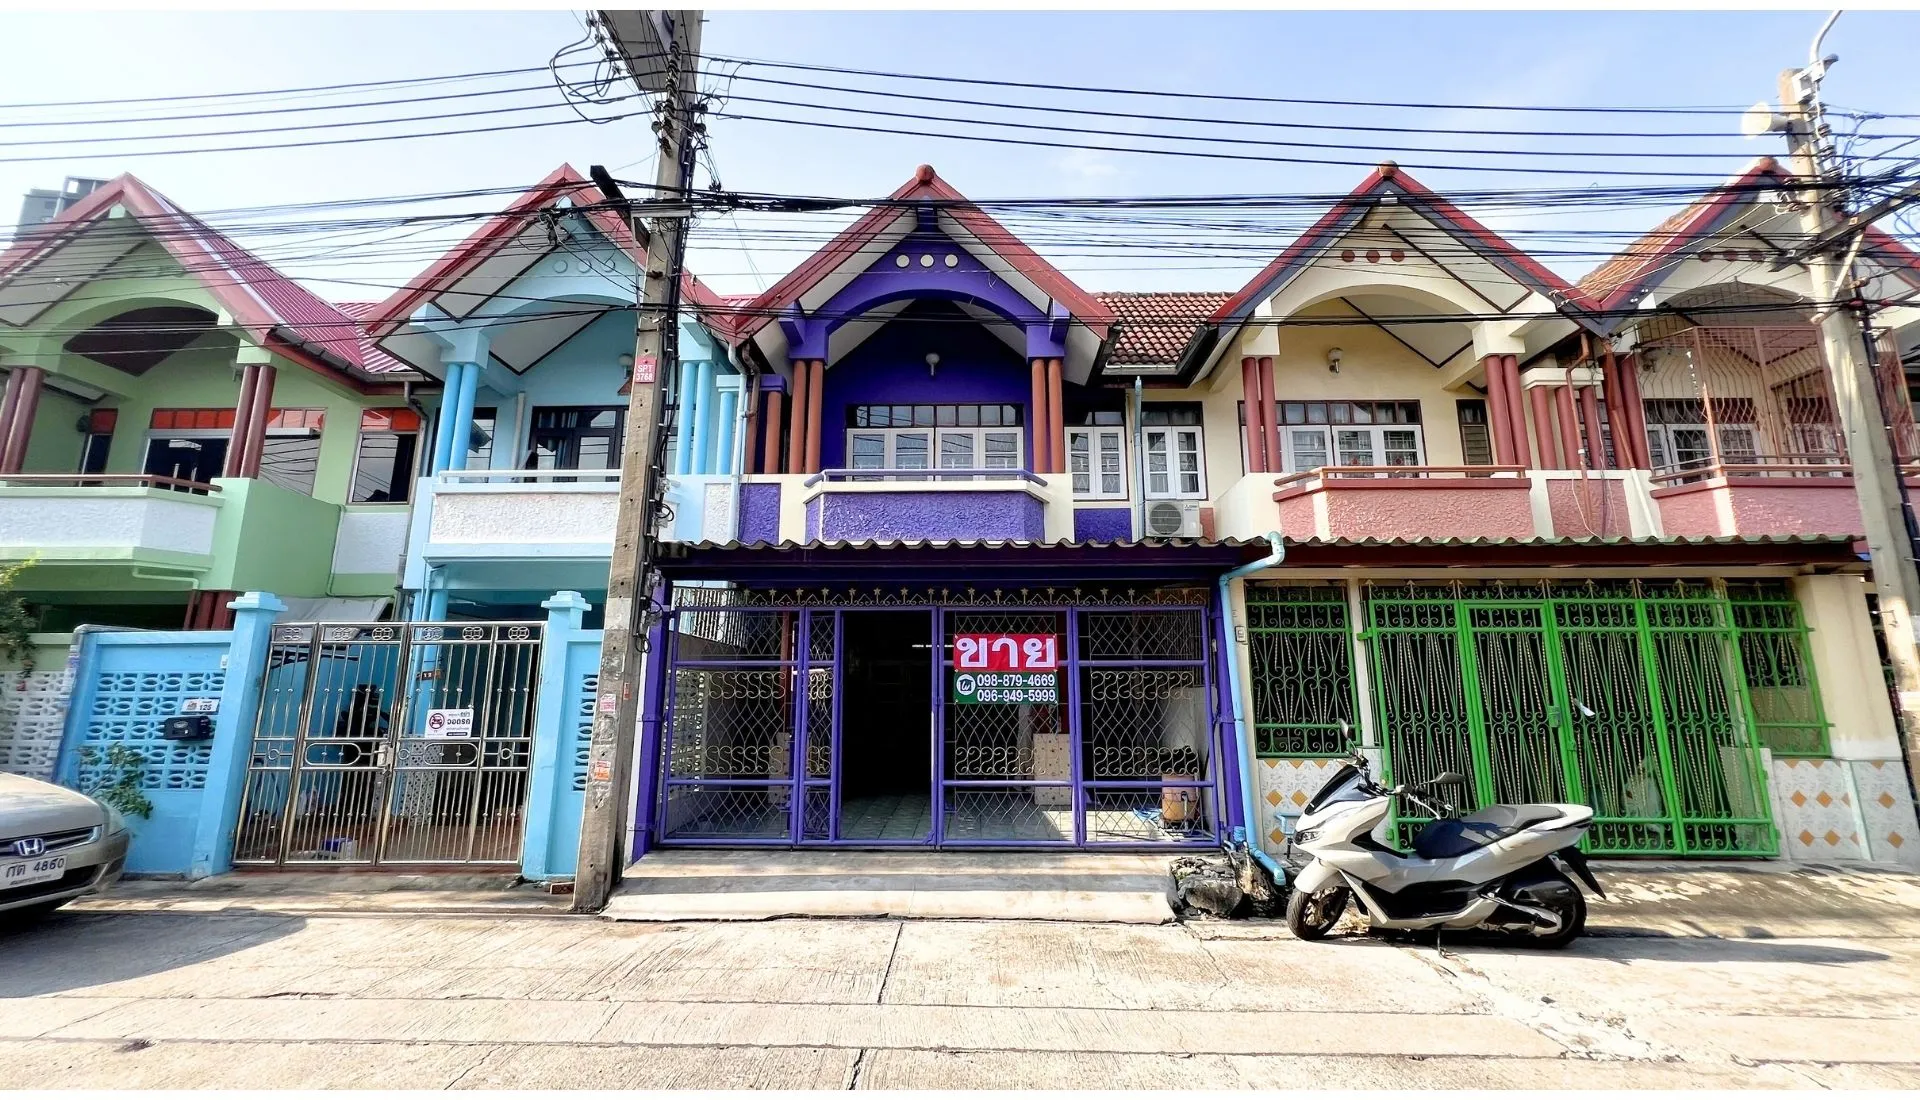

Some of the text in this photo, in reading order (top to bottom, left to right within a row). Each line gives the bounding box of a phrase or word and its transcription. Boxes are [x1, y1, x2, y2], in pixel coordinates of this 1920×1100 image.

[637, 364, 654, 373] SPT
[636, 373, 653, 381] 3768
[956, 637, 1056, 668] ขาย
[976, 673, 1056, 687] 098-879-4669
[976, 689, 1056, 702] 096-949-5999
[33, 858, 65, 872] 4860
